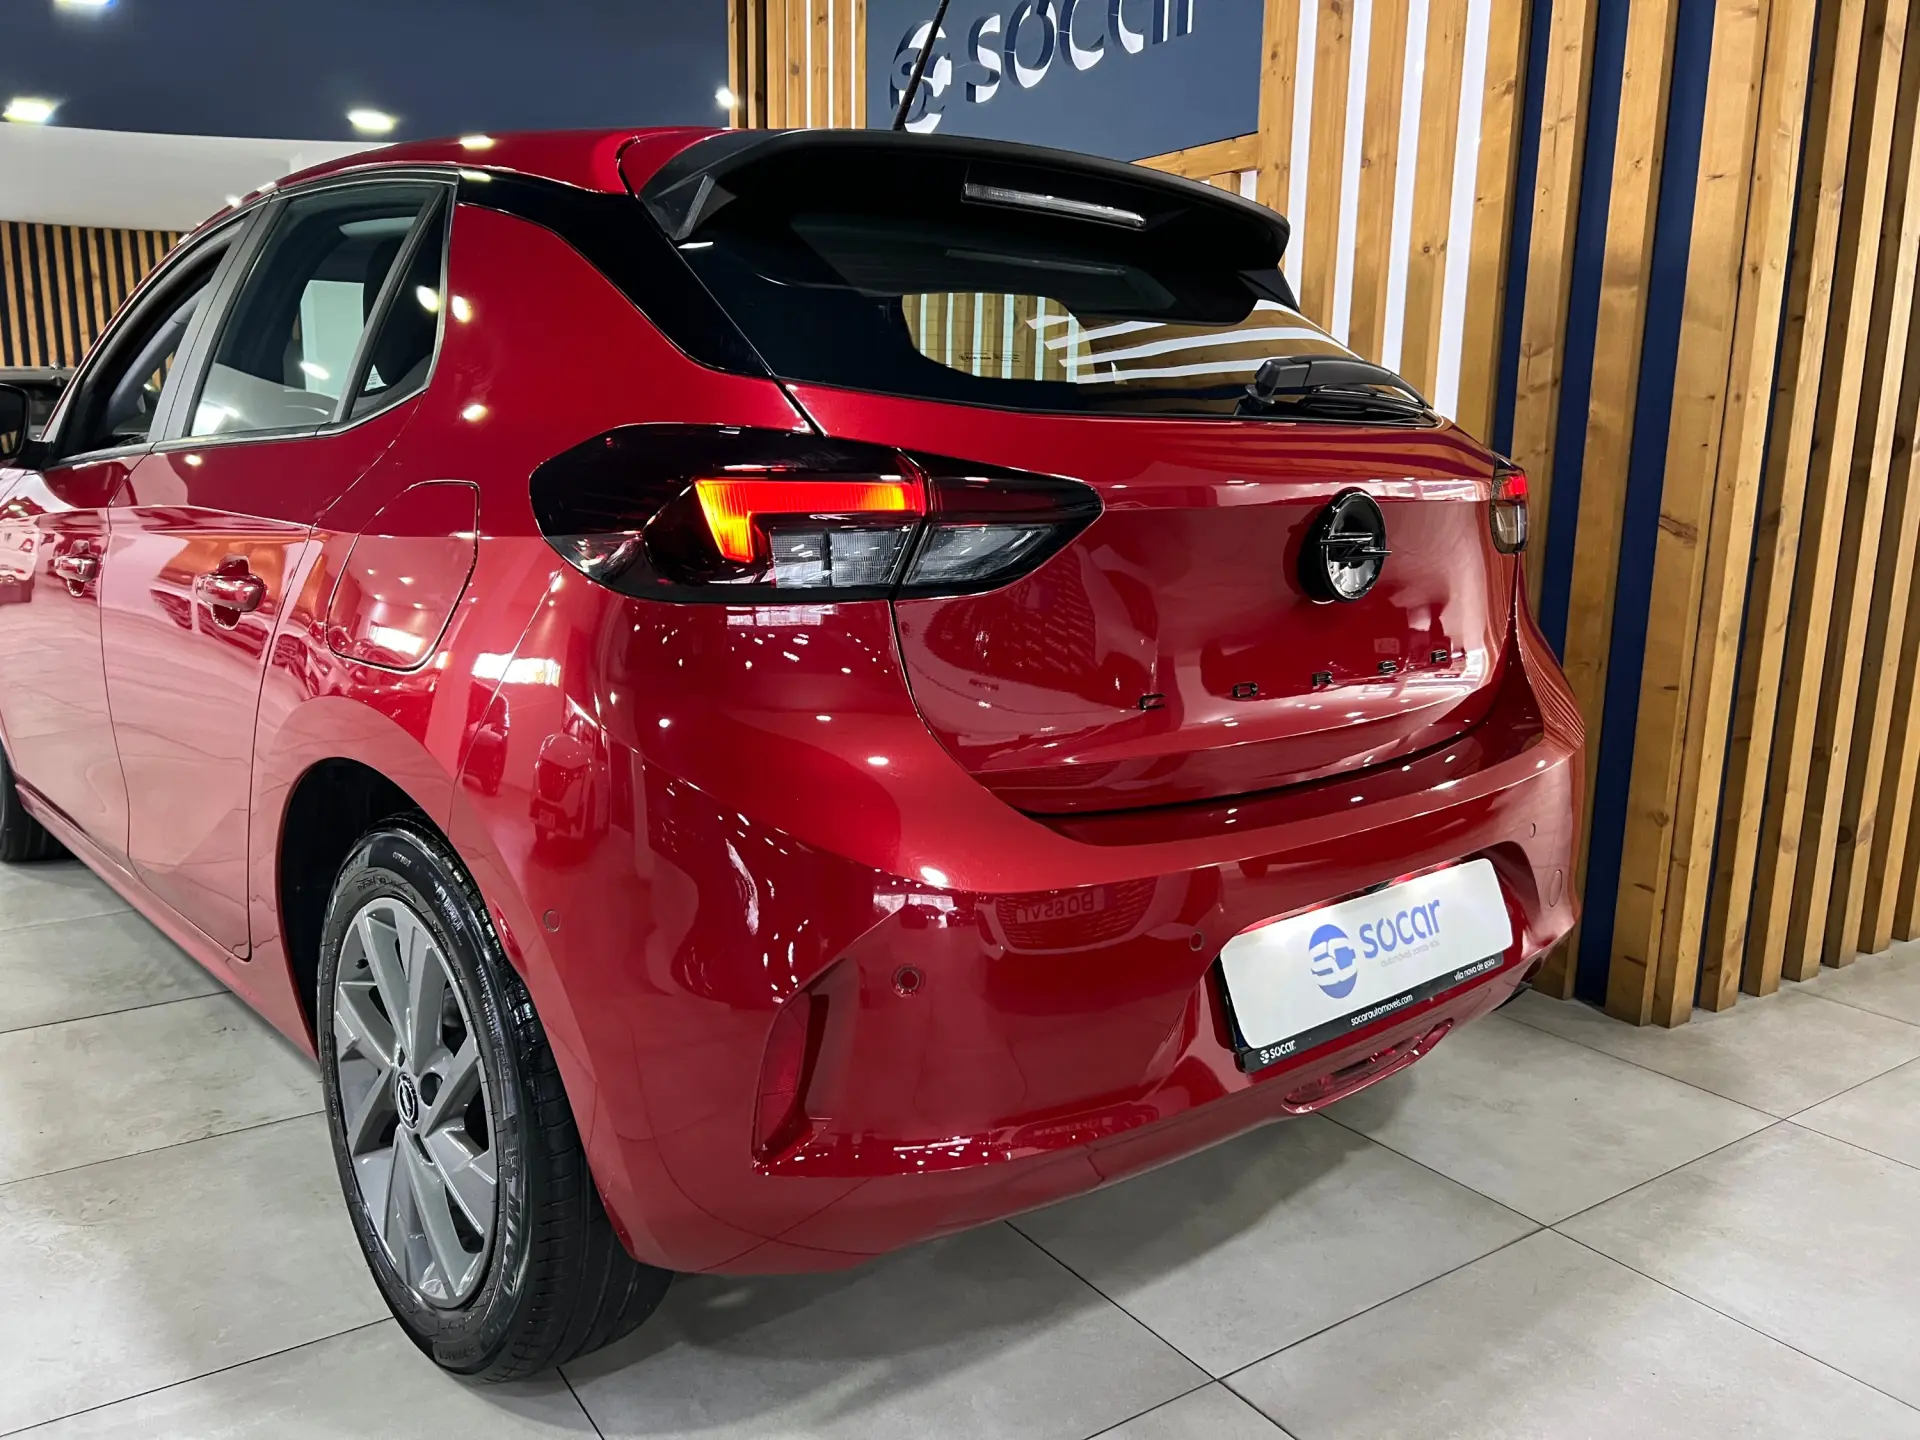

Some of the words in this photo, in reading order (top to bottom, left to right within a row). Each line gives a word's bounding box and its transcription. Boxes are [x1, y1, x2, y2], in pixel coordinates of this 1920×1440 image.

[1359, 899, 1440, 958] socar
[1477, 961, 1484, 971] de
[1350, 994, 1413, 1026] socarautomoveis.com
[1270, 1039, 1296, 1059] socar
